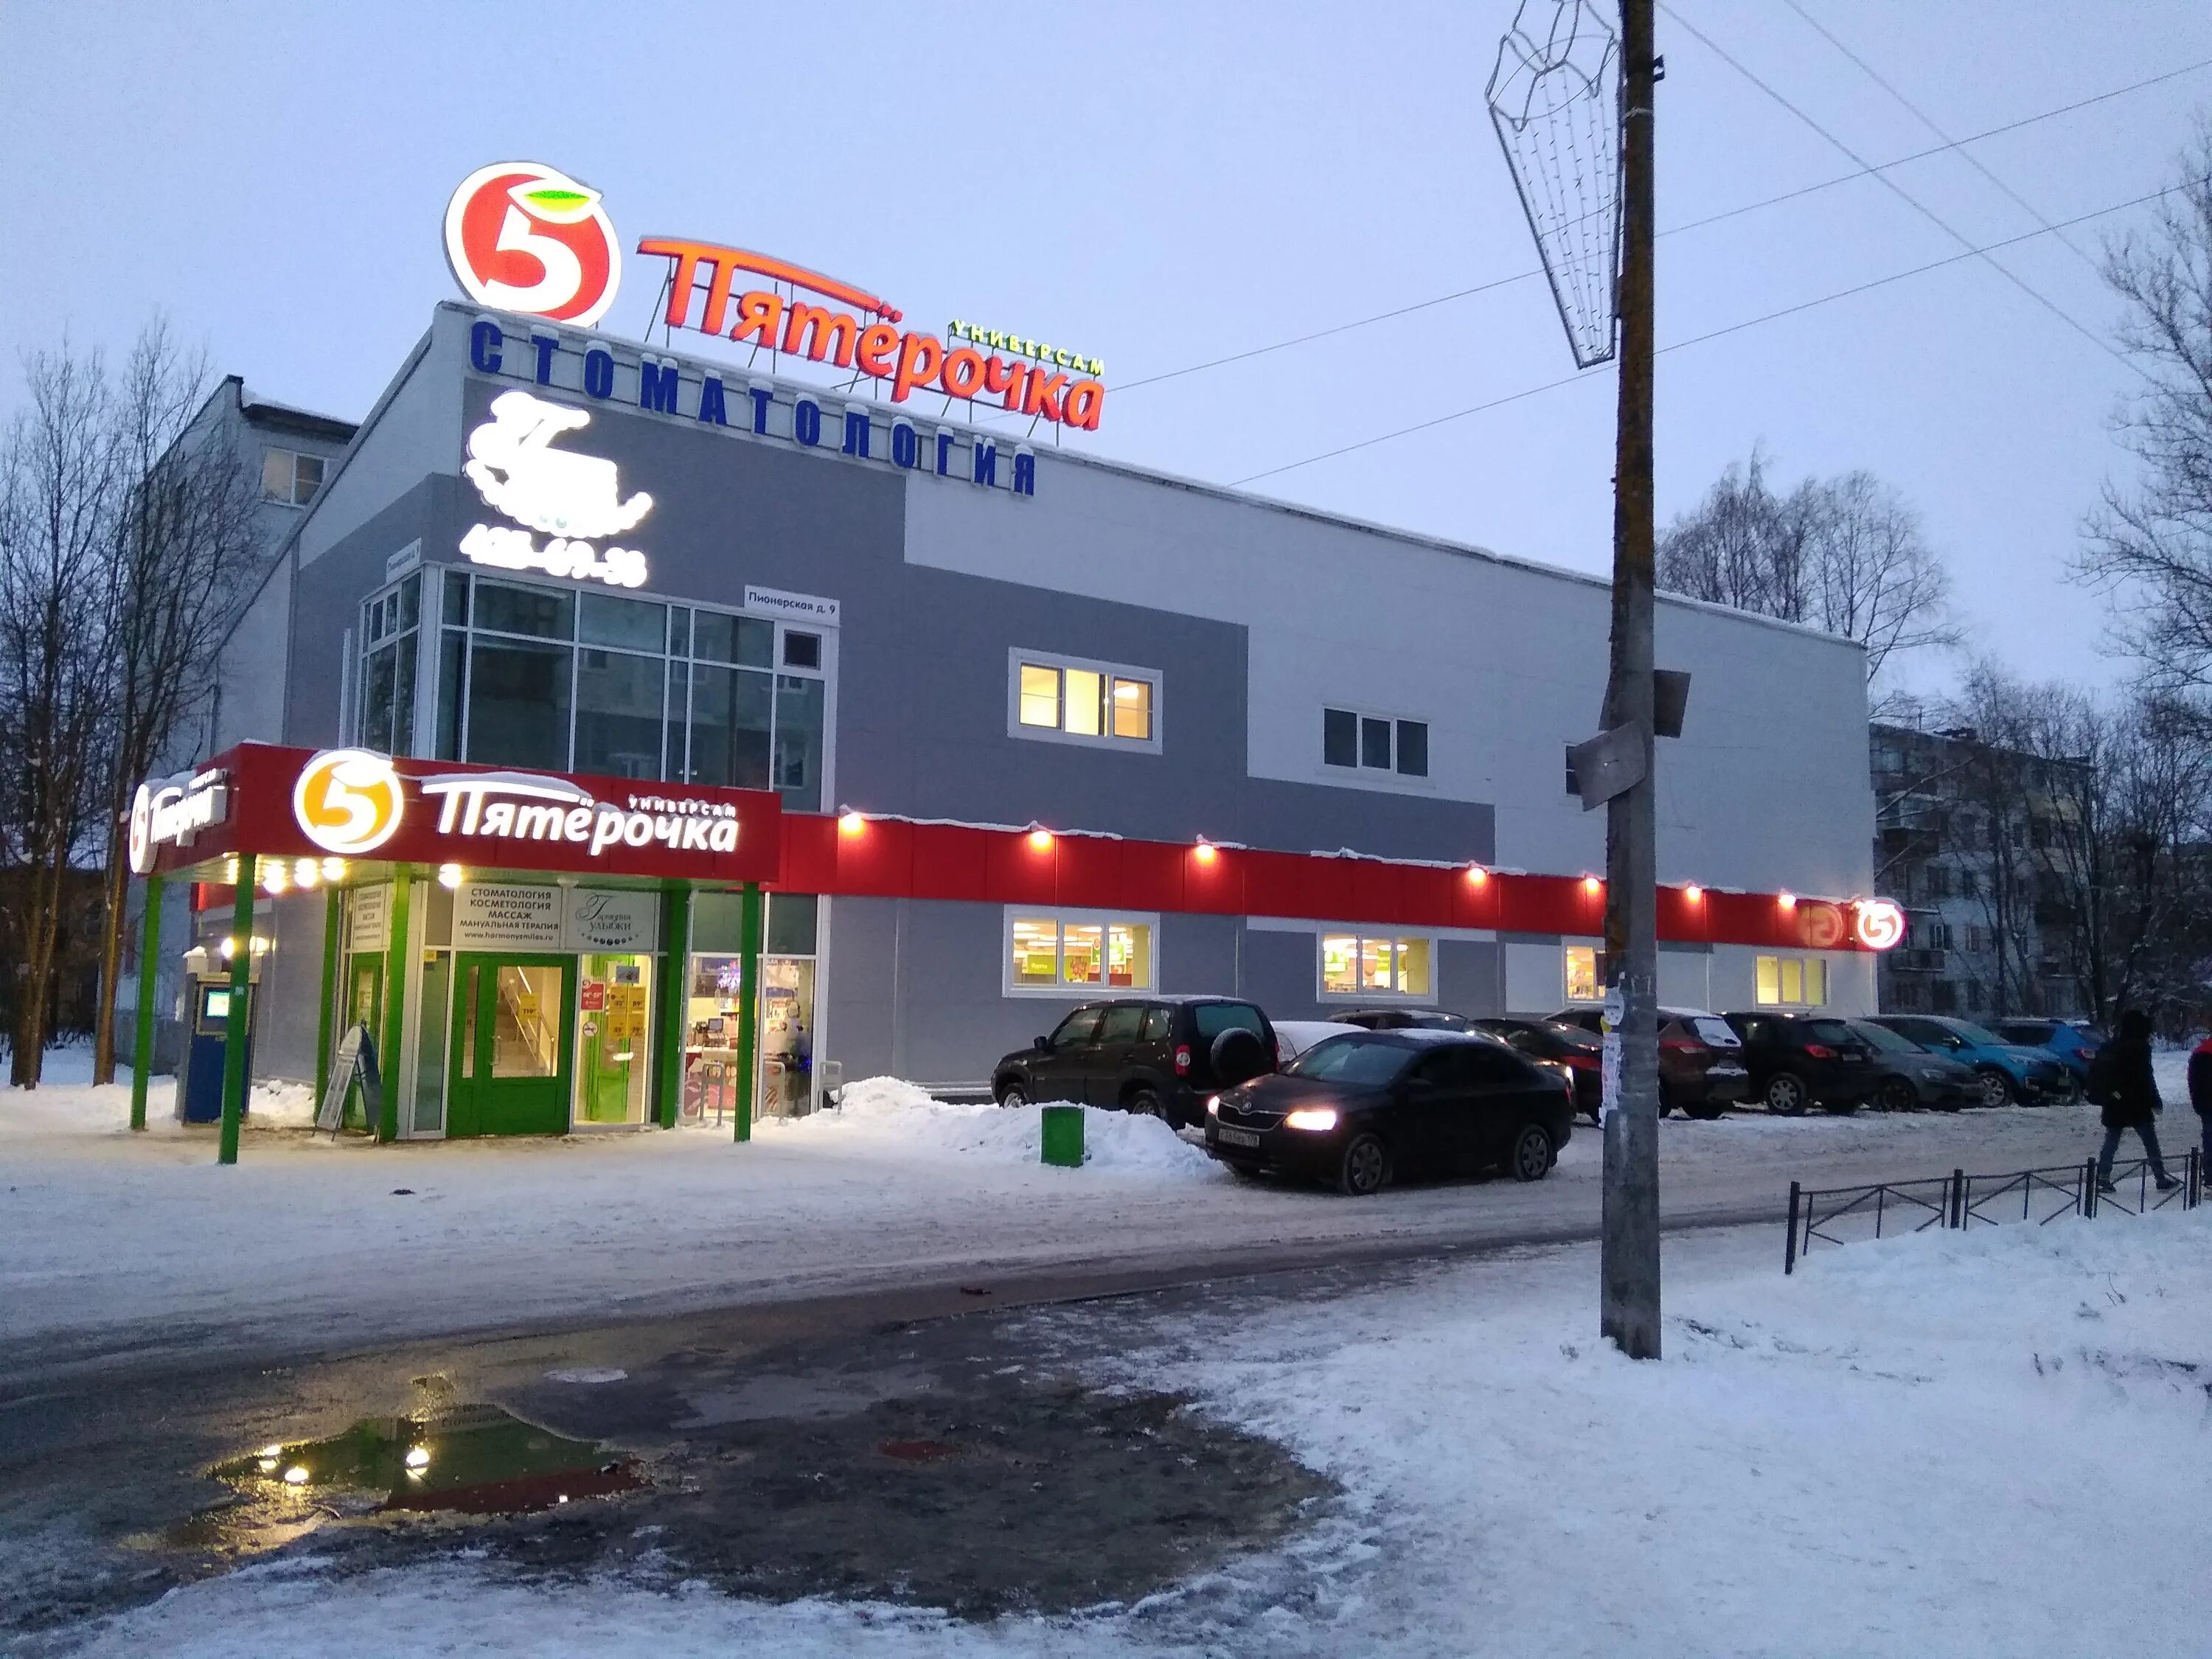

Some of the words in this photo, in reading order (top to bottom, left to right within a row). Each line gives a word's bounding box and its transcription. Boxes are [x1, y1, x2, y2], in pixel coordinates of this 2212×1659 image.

[479, 180, 605, 313] 5
[636, 239, 1105, 431] Пятёрочка
[951, 319, 1105, 376] УНИВЕРСАМ
[470, 320, 1035, 496] СТОМАТОЛОГИЯ
[748, 591, 813, 611] Пионерская
[816, 604, 825, 613] д.
[830, 605, 836, 614] 9
[313, 759, 393, 844] 5
[421, 780, 738, 856] Пятёрочка
[629, 797, 736, 818] УНИВЕРСАМ
[470, 899, 551, 911] КОСМЕТОЛОГИЯ
[471, 888, 552, 900] СТОМАТОЛОГИЯ
[459, 919, 520, 929] МАНУАЛЬНАЯ
[522, 922, 559, 931] ТЕРАПИЯ
[488, 911, 532, 920] МАССАЖ
